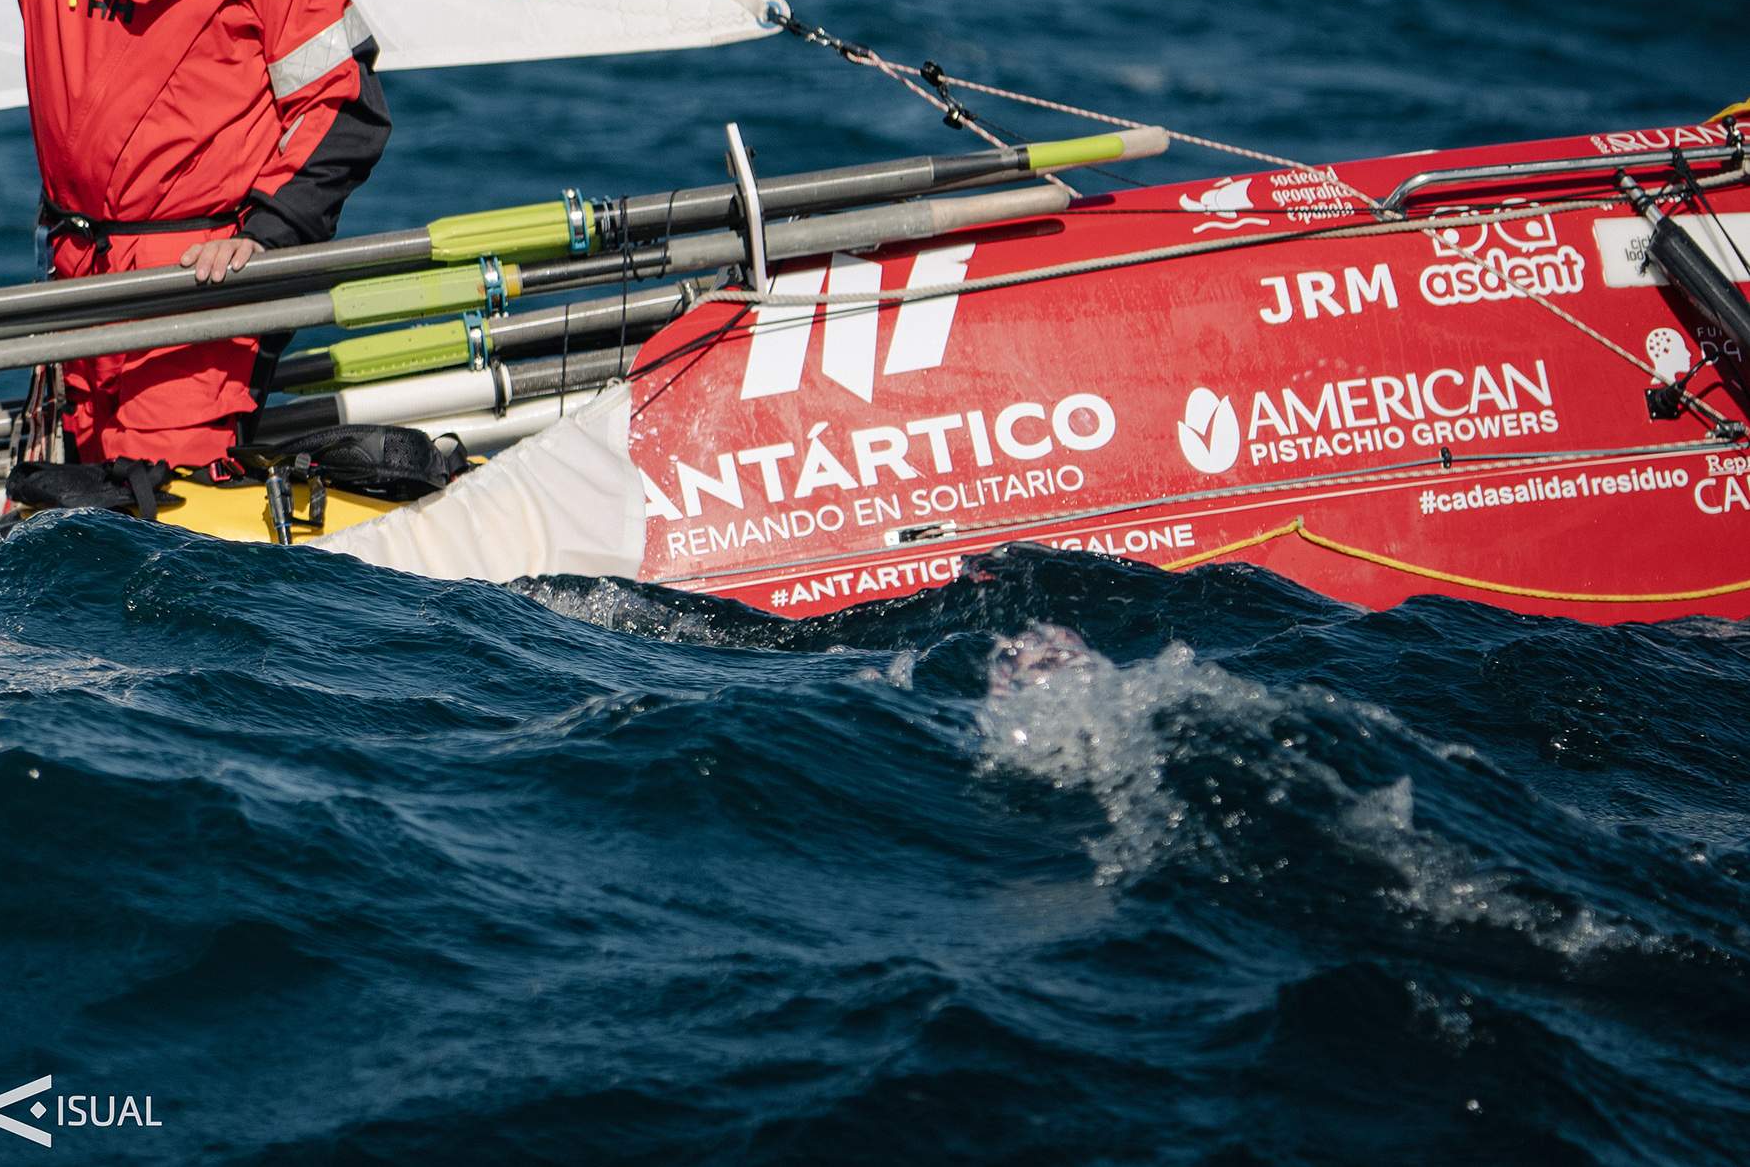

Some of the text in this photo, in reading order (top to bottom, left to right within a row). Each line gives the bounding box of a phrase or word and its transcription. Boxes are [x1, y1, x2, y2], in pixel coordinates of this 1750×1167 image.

[1259, 263, 1399, 325] JRM
[1420, 246, 1584, 305] asdent
[1248, 359, 1553, 440] AMERICAN
[1250, 410, 1559, 466] PISTACHIO GROWERS
[1705, 454, 1750, 476] Rep
[668, 464, 1084, 560] REMANDO EN SOLITARIO
[1418, 465, 1689, 515] #cadasalida1residuo
[1694, 476, 1750, 514] CA
